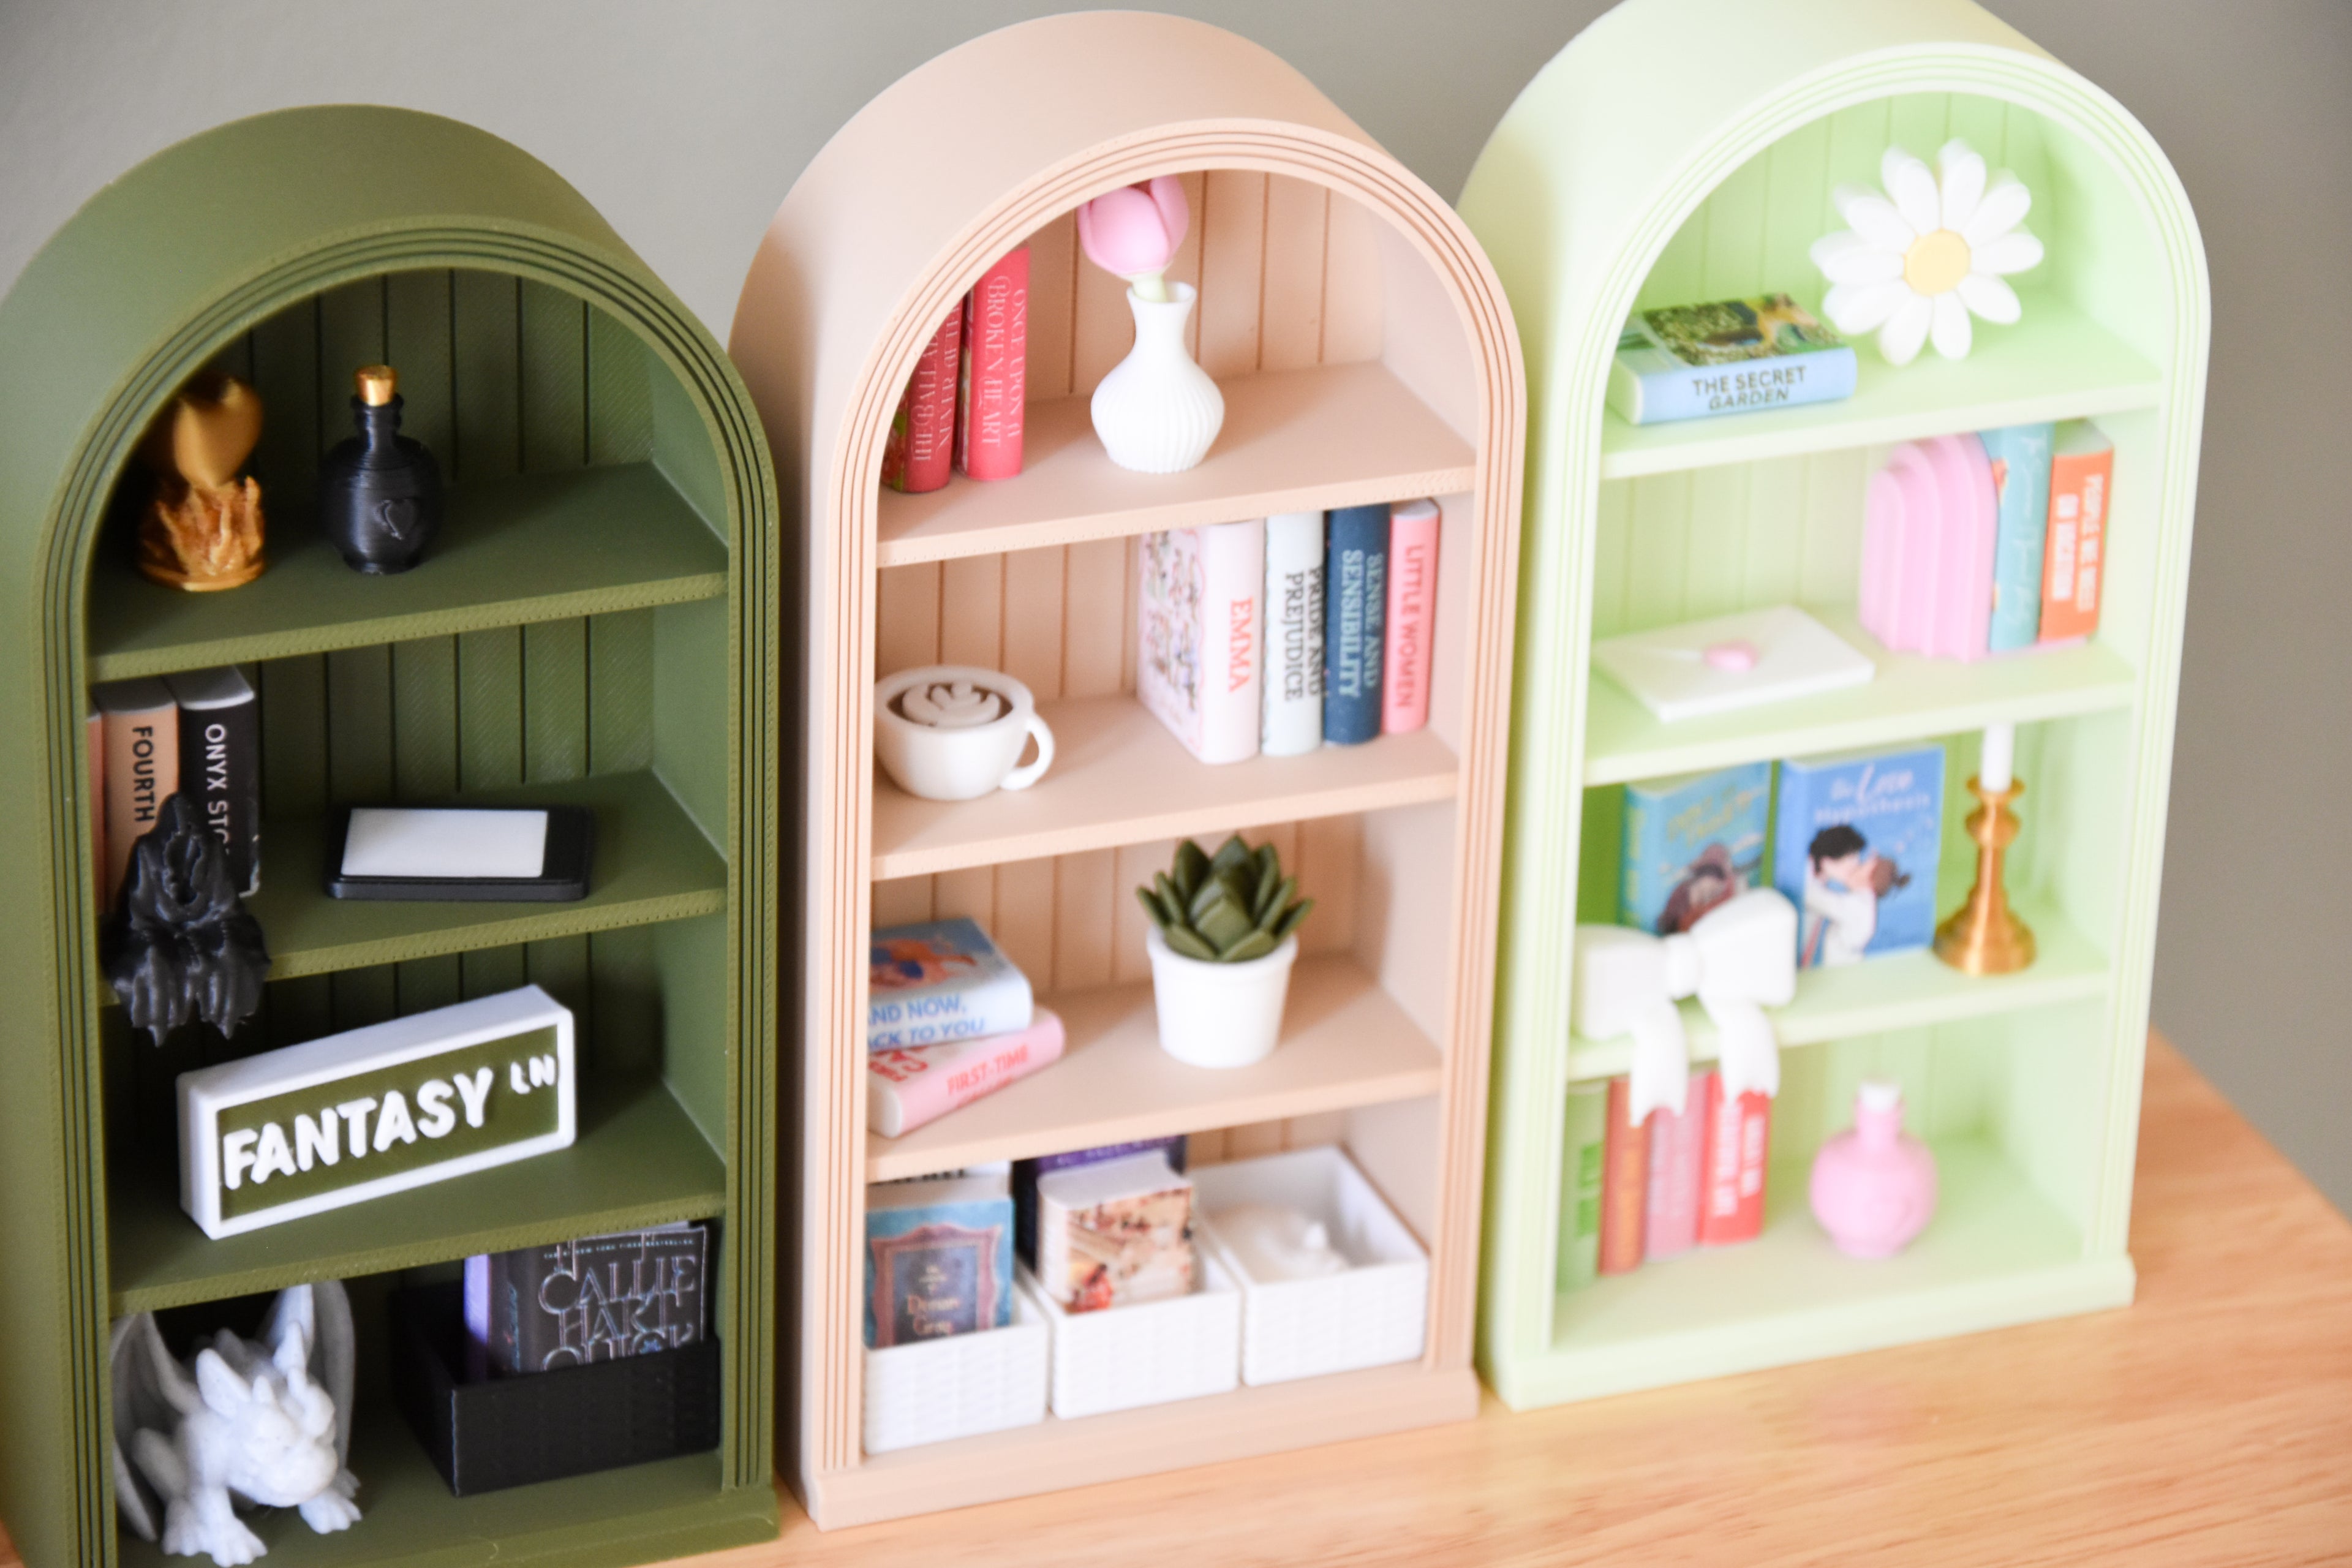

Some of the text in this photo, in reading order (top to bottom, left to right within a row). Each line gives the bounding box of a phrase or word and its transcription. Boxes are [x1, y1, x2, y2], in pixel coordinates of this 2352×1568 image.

[1010, 288, 1026, 349] ONCE
[981, 275, 1011, 447] BROKEN HEART
[1008, 355, 1025, 417] UPON
[1692, 366, 1806, 396] THE SECRET
[1709, 388, 1787, 409] GARDEN
[914, 428, 932, 461] THE
[1228, 596, 1254, 693] EMMA
[1281, 570, 1304, 702] PREJUDICE
[1340, 549, 1363, 698] SENSIBILITY
[1365, 552, 1383, 688] SENSE AND
[1395, 544, 1427, 708] LITTLE WOMEN
[132, 726, 155, 821] FOURTH
[205, 723, 228, 790] ONYX
[869, 1003, 902, 1025] ND
[910, 1024, 936, 1041] TO
[941, 1017, 984, 1036] YOU
[223, 1054, 558, 1191] FANTASY LN
[538, 1253, 696, 1314] CALLIE
